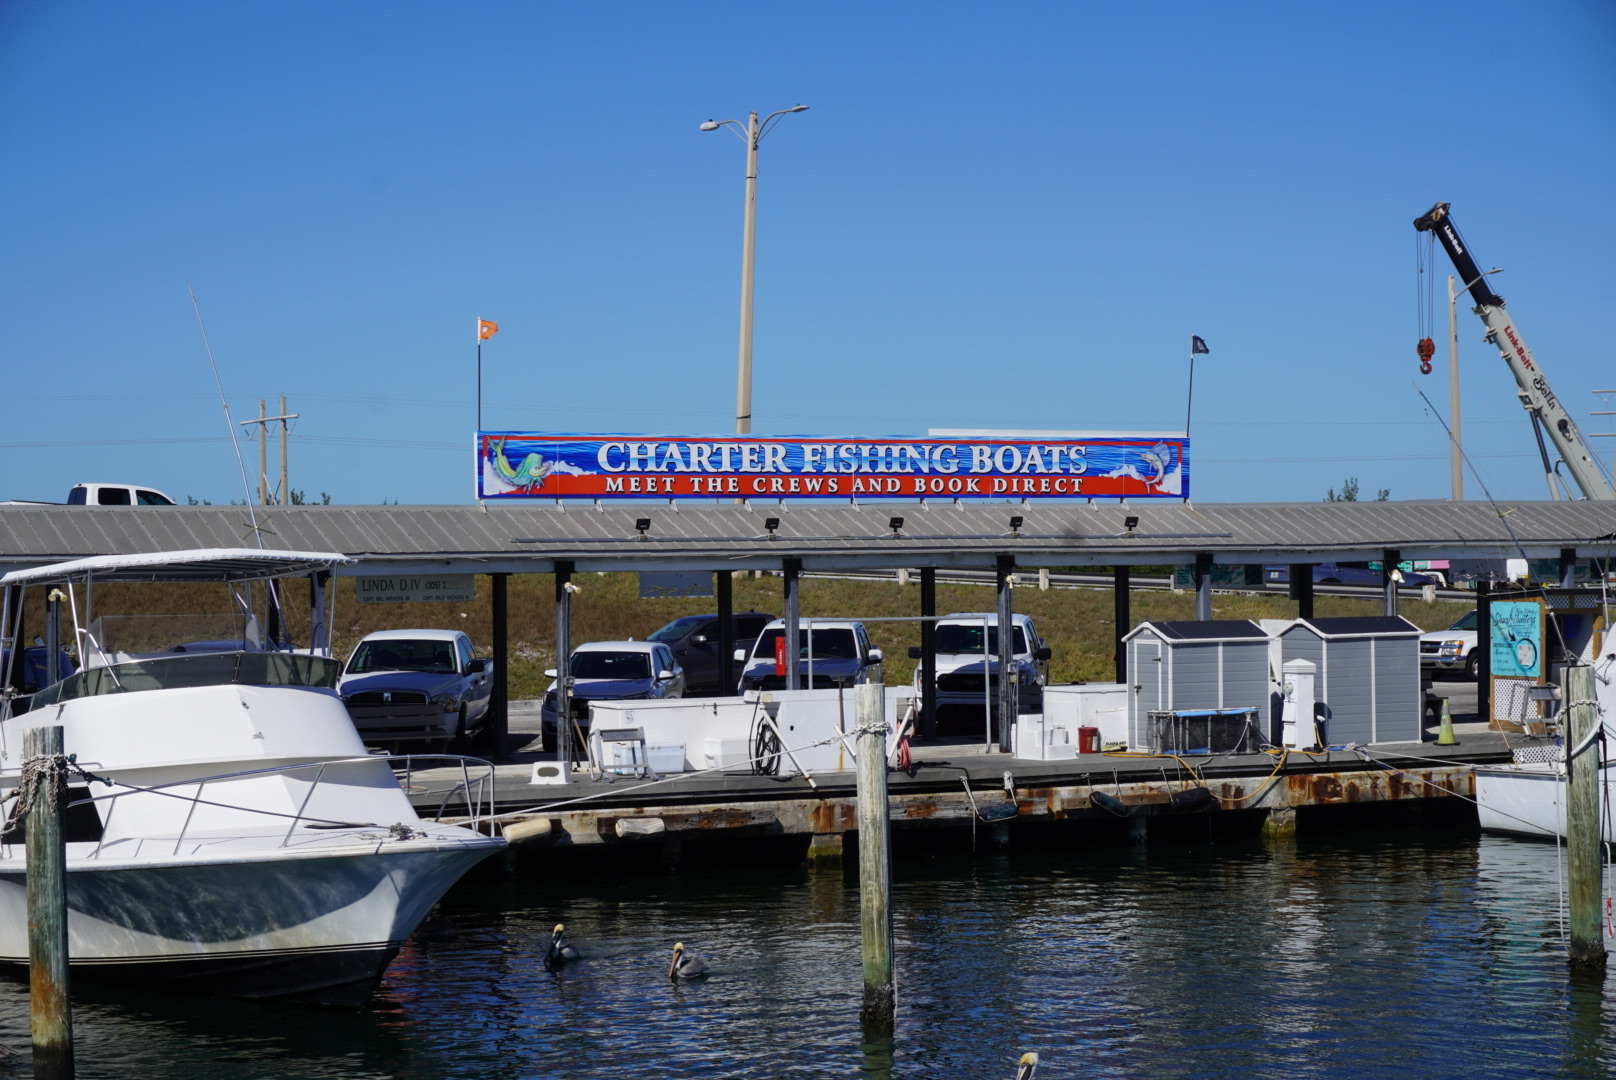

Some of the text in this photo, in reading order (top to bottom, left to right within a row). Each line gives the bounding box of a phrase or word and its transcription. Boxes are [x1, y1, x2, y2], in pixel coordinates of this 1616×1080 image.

[1444, 224, 1463, 255] Link-Belt
[1503, 325, 1533, 370] Link-Belt
[597, 442, 1089, 475] CHARTER FISHING BOATS
[605, 477, 1084, 493] MEET THE CREWS AND BOOK DIRECT
[362, 579, 395, 592] LINDA
